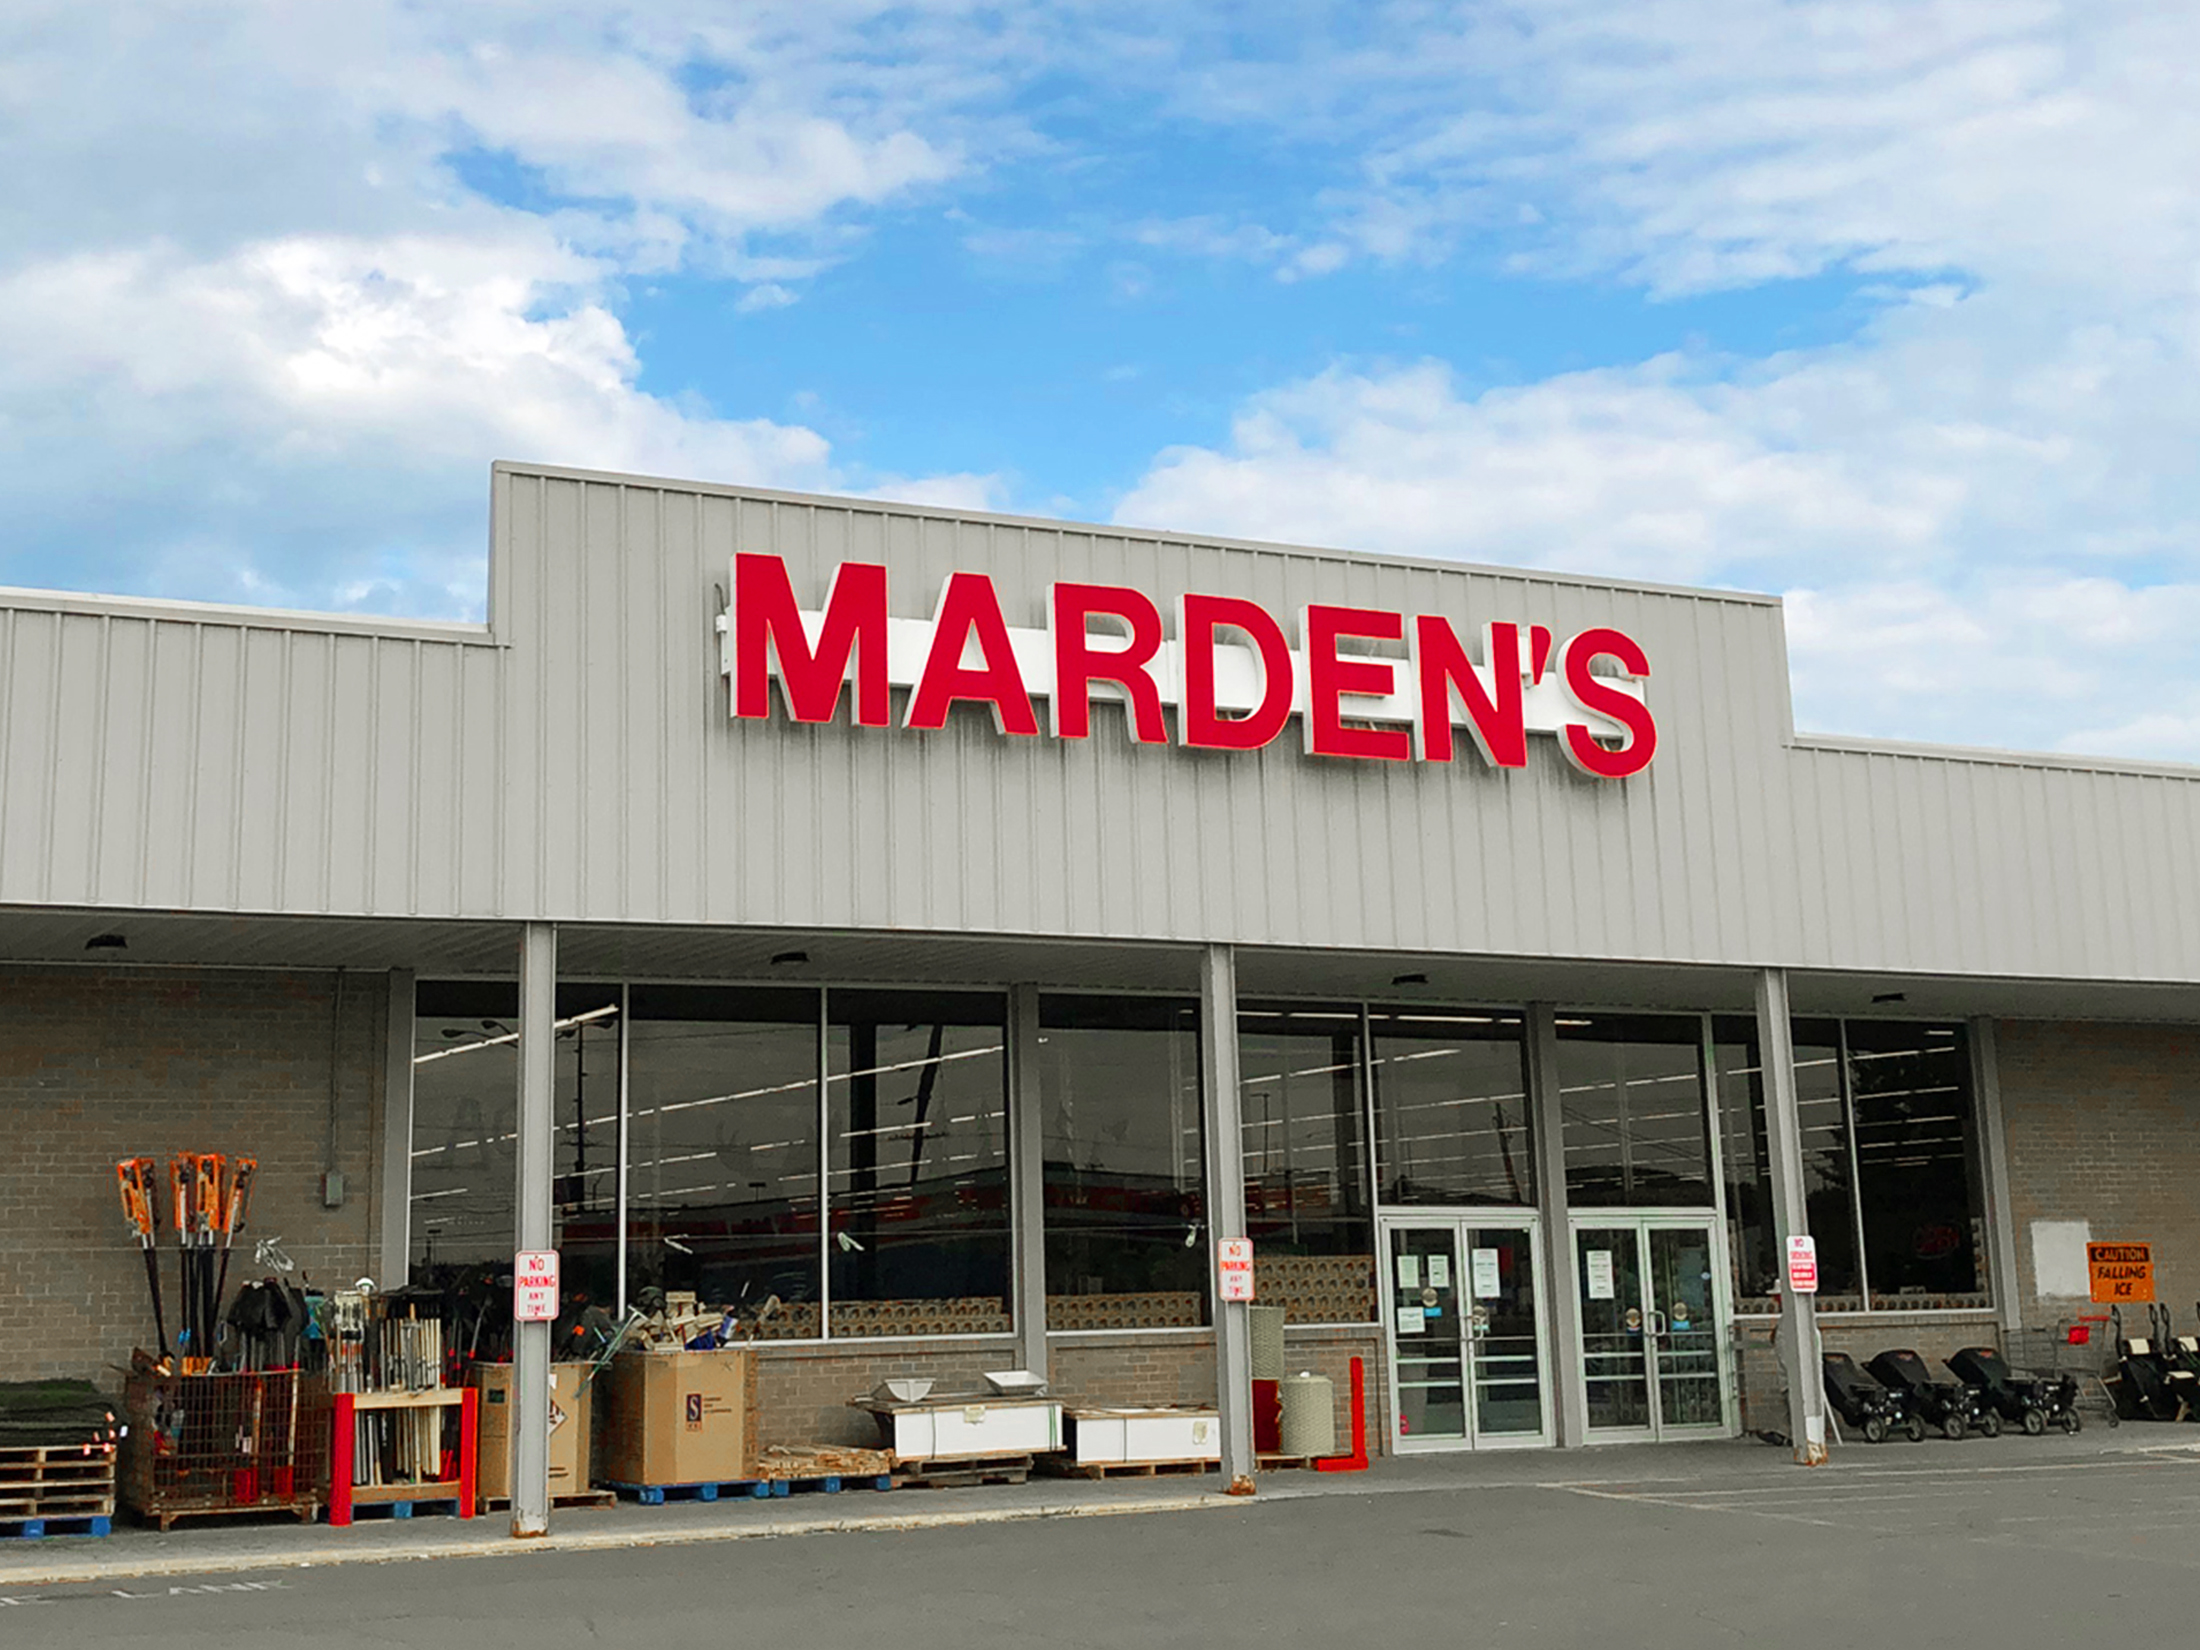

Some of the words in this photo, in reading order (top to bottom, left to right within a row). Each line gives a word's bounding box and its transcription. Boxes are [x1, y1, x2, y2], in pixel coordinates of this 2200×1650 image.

[733, 552, 1657, 778] MARDEN'S
[1229, 1245, 1242, 1256] NO
[2095, 1248, 2146, 1260] CAUTION
[529, 1258, 544, 1271] NO
[1220, 1261, 1250, 1271] PARKING
[2098, 1266, 2146, 1279] FALLING
[518, 1275, 555, 1287] PARKING
[2114, 1282, 2133, 1295] ICE
[528, 1292, 544, 1300] ANY
[527, 1304, 546, 1313] TIME
